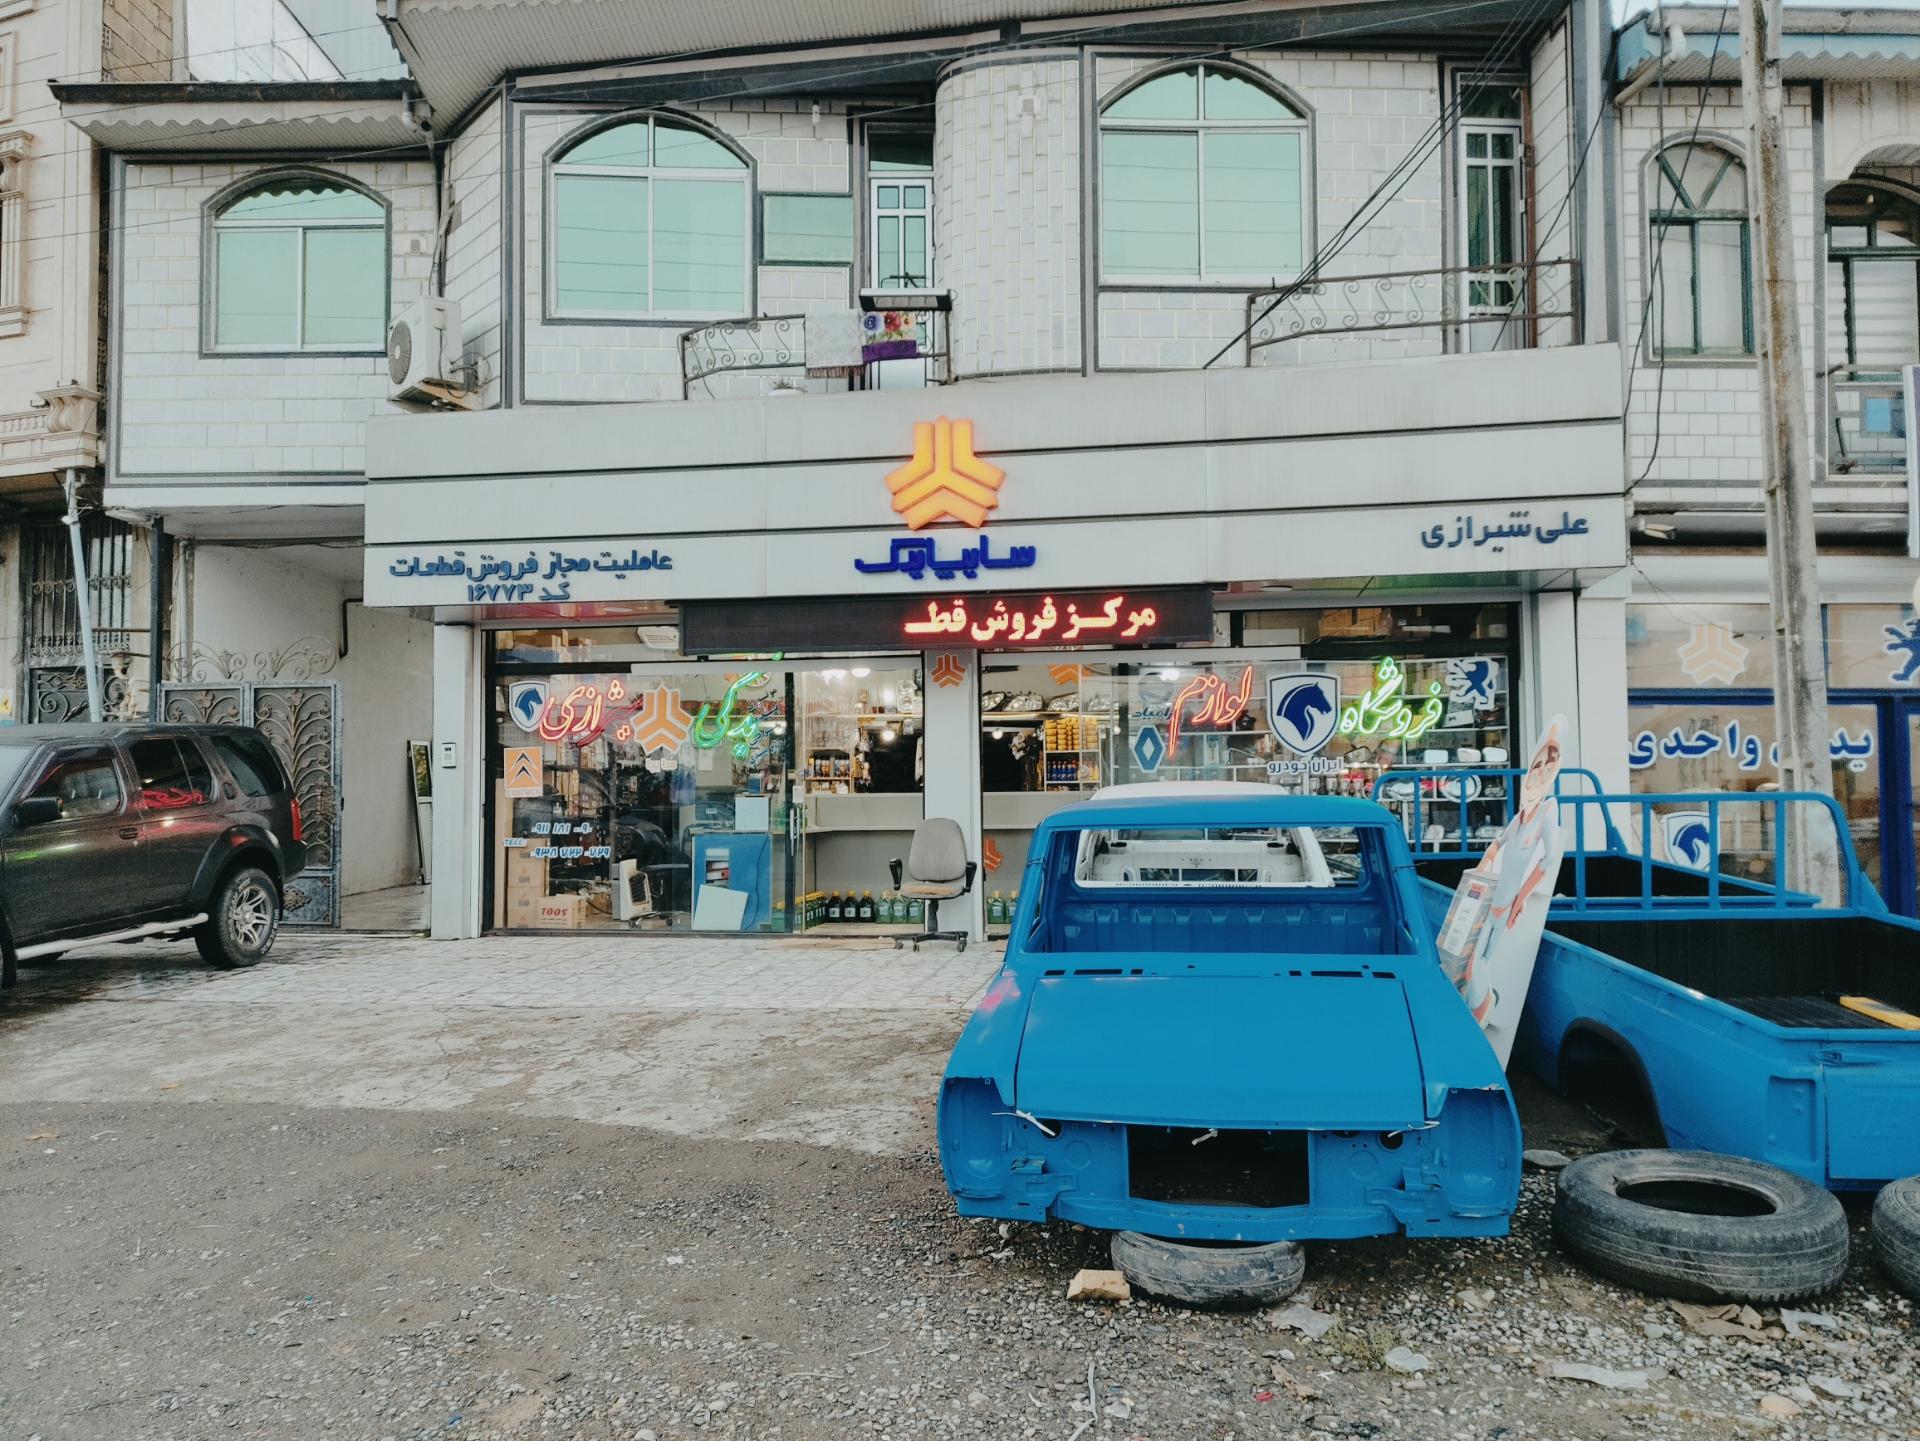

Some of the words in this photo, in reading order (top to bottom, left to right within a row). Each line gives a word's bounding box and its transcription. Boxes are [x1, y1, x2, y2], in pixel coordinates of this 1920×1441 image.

[1421, 511, 1532, 553] شیرازی
[1535, 511, 1589, 544] علی
[389, 551, 465, 577] قطعات
[466, 551, 538, 582] فروش
[543, 551, 590, 579] مجاز
[593, 550, 673, 579] عاملیت
[468, 583, 534, 602] ۱۶۷۷۳
[539, 582, 570, 600] کد
[970, 597, 1058, 641] فروش
[1062, 597, 1157, 639] مرکز
[1167, 665, 1253, 760] لوازم
[1340, 656, 1443, 739] فروشگاه
[1627, 718, 1765, 770] واحدی
[1267, 760, 1309, 775] خودرو
[1310, 757, 1344, 775] ایران
